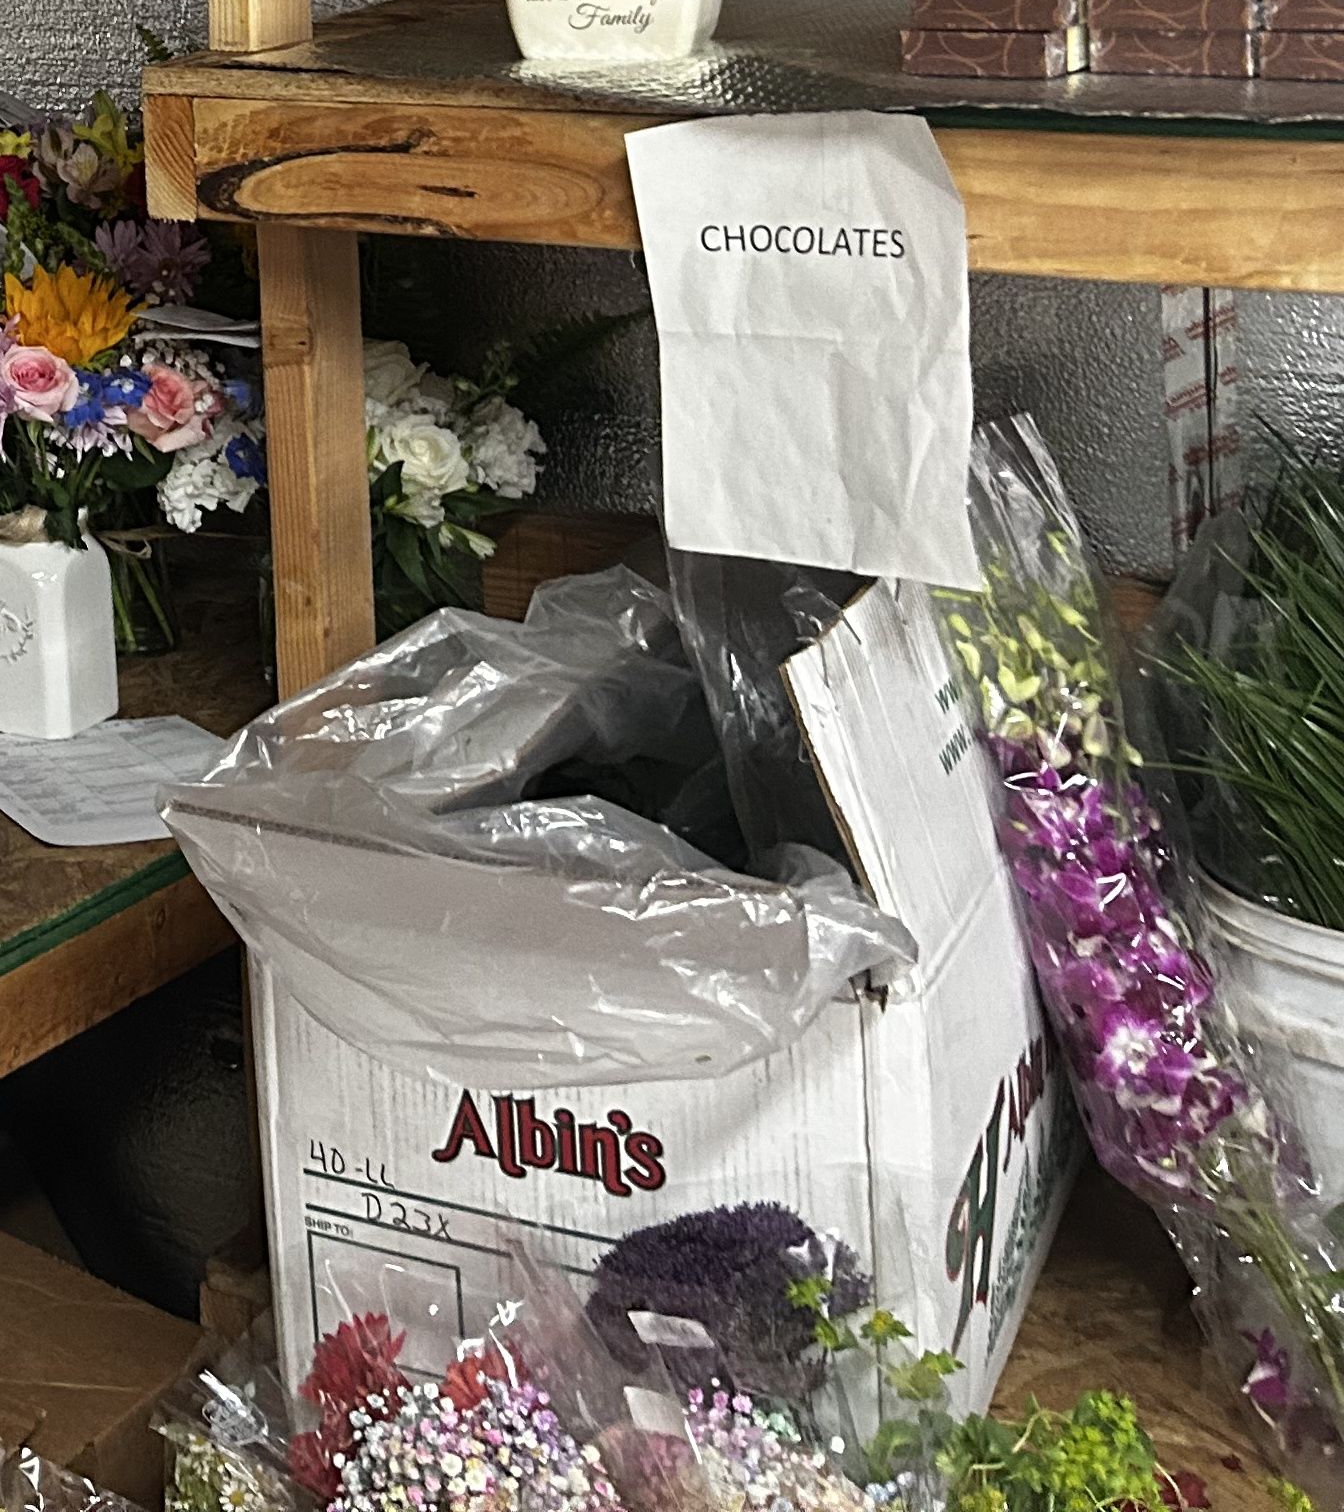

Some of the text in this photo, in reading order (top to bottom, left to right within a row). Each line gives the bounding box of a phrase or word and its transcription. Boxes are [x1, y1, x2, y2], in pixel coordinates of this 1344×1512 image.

[568, 3, 652, 33] Family
[700, 225, 905, 259] CHOCOLATES
[431, 1088, 667, 1198] Albin's
[304, 1216, 331, 1231] SHIP
